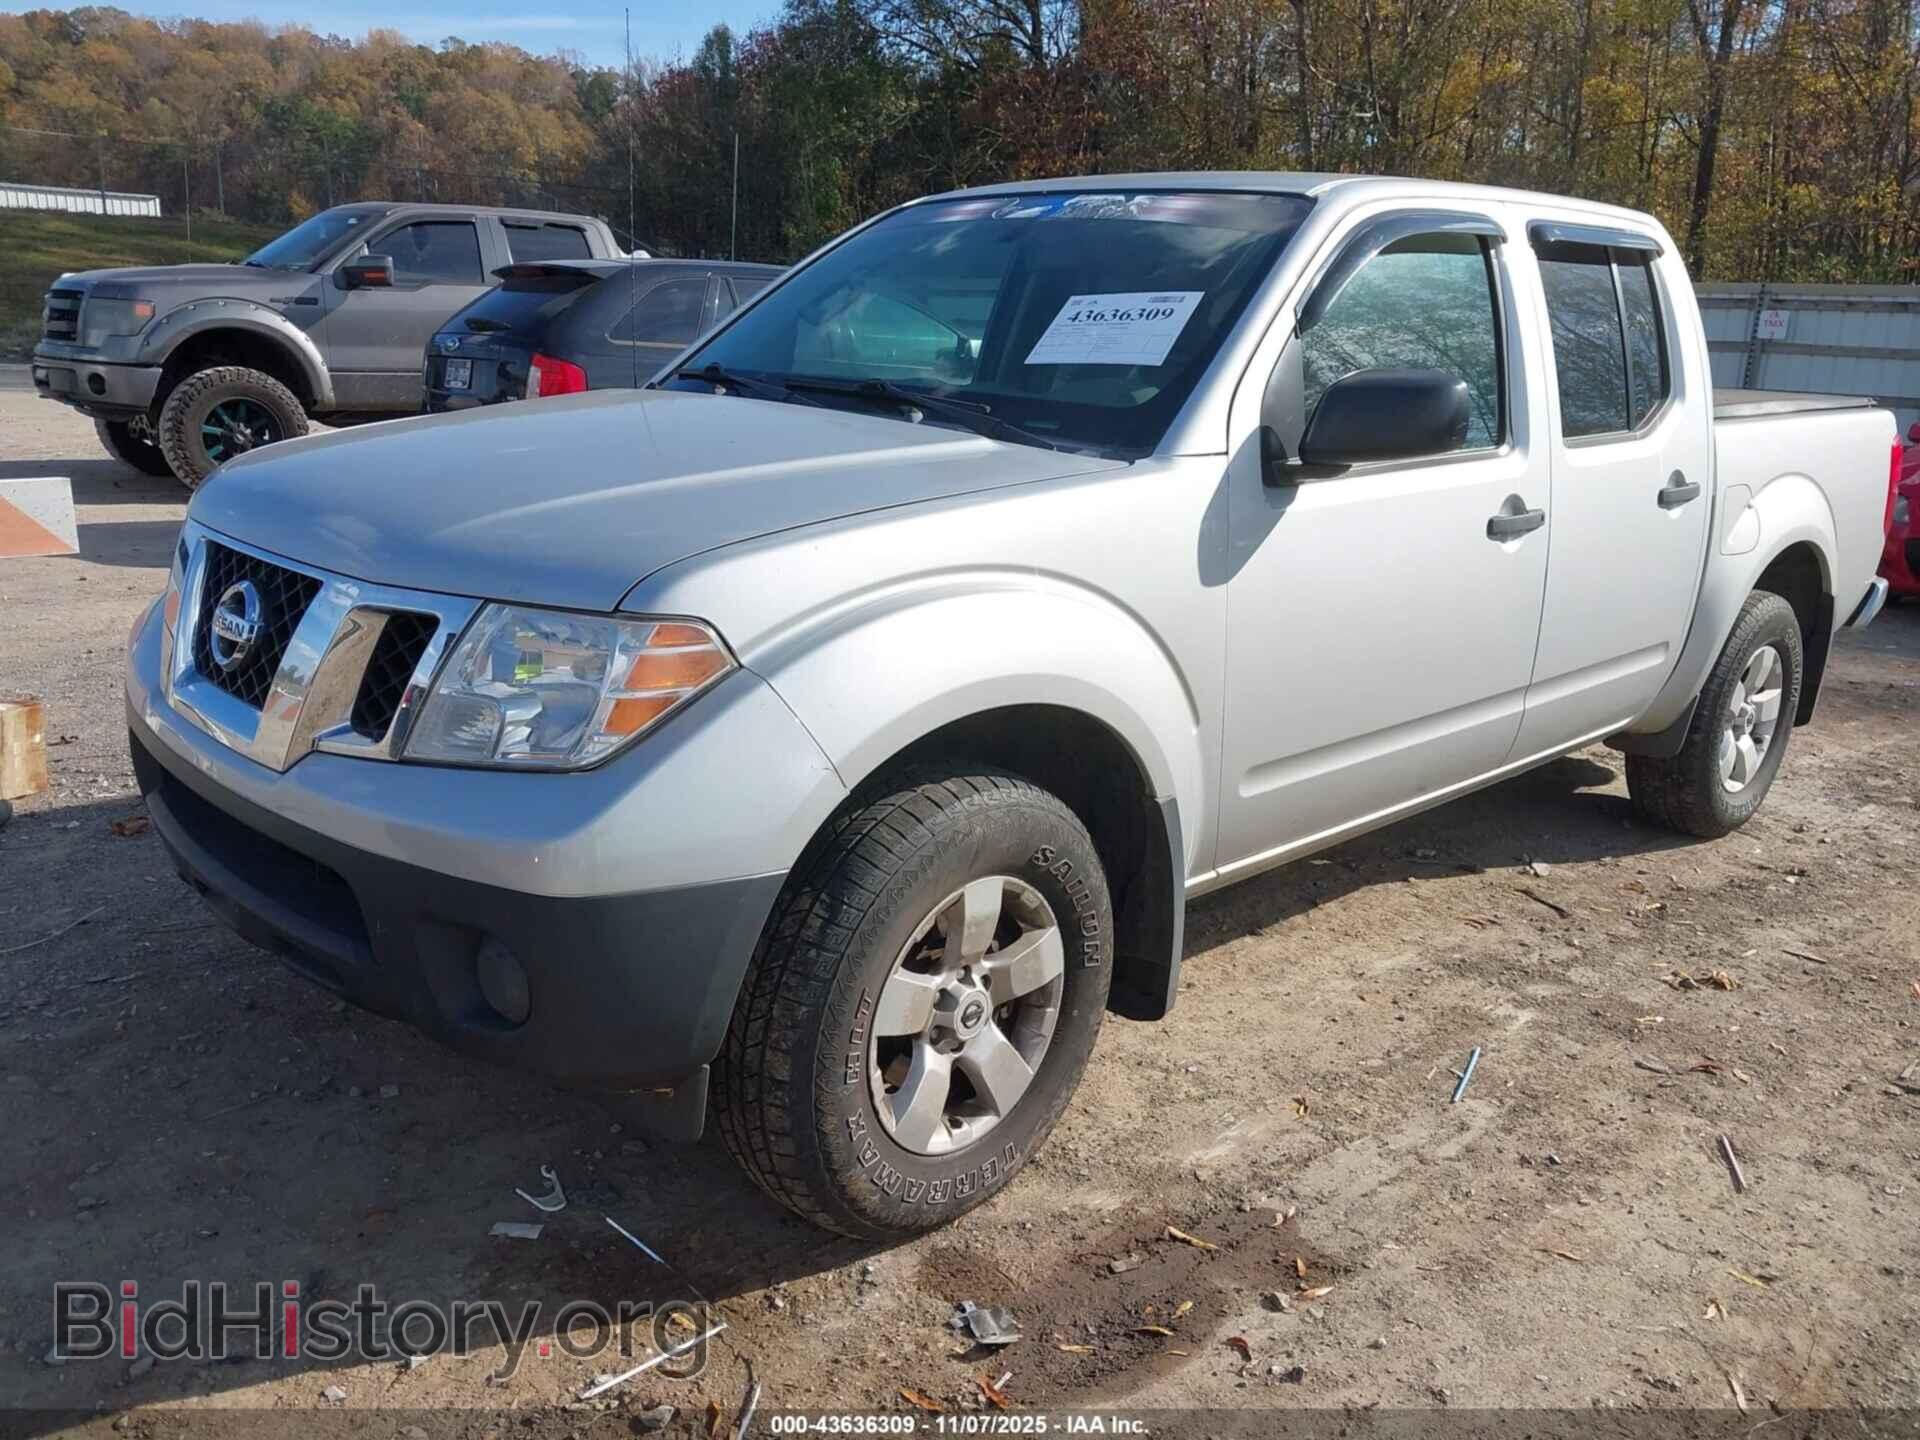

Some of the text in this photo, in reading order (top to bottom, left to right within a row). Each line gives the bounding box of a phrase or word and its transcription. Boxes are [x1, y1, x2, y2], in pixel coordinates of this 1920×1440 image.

[1067, 307, 1174, 322] 43636309
[1032, 844, 1101, 967] SAILUN
[846, 1108, 1020, 1204] TERRAMAX
